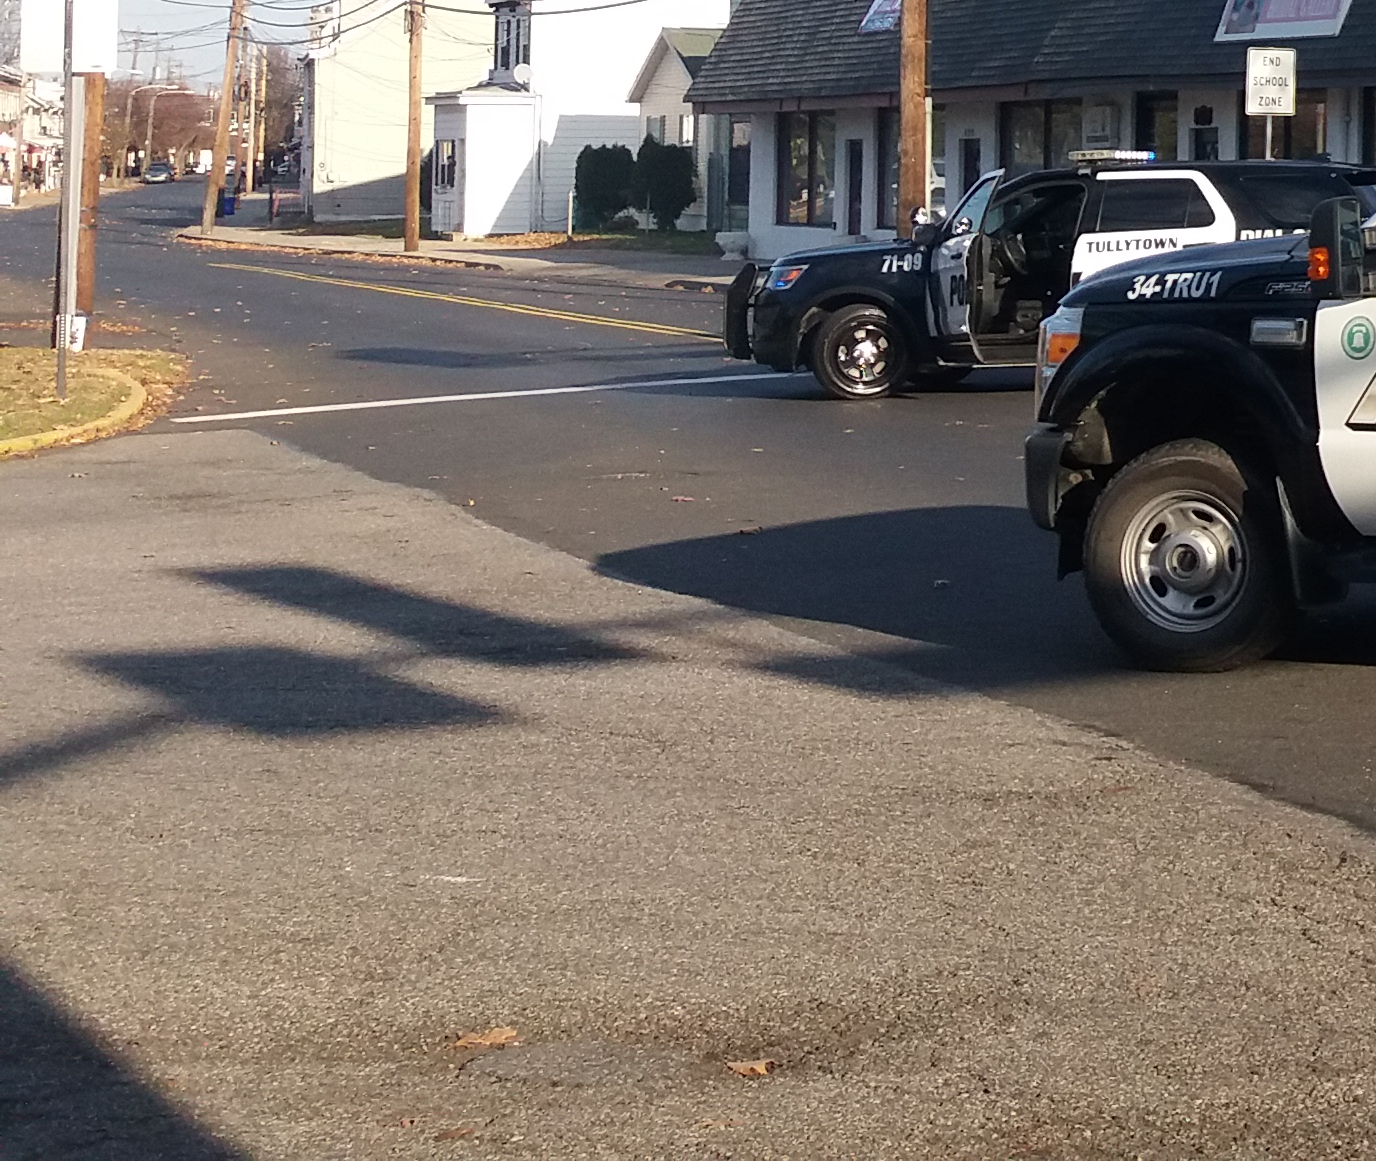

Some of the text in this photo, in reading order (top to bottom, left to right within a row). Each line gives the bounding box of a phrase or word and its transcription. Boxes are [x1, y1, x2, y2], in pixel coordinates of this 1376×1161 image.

[1263, 56, 1281, 67] END
[1253, 76, 1290, 87] SCHOOL
[1258, 96, 1283, 107] ZONE
[1086, 237, 1178, 253] TULLYTOWN
[881, 253, 923, 273] 71-09
[1126, 271, 1223, 300] 34-TRU1
